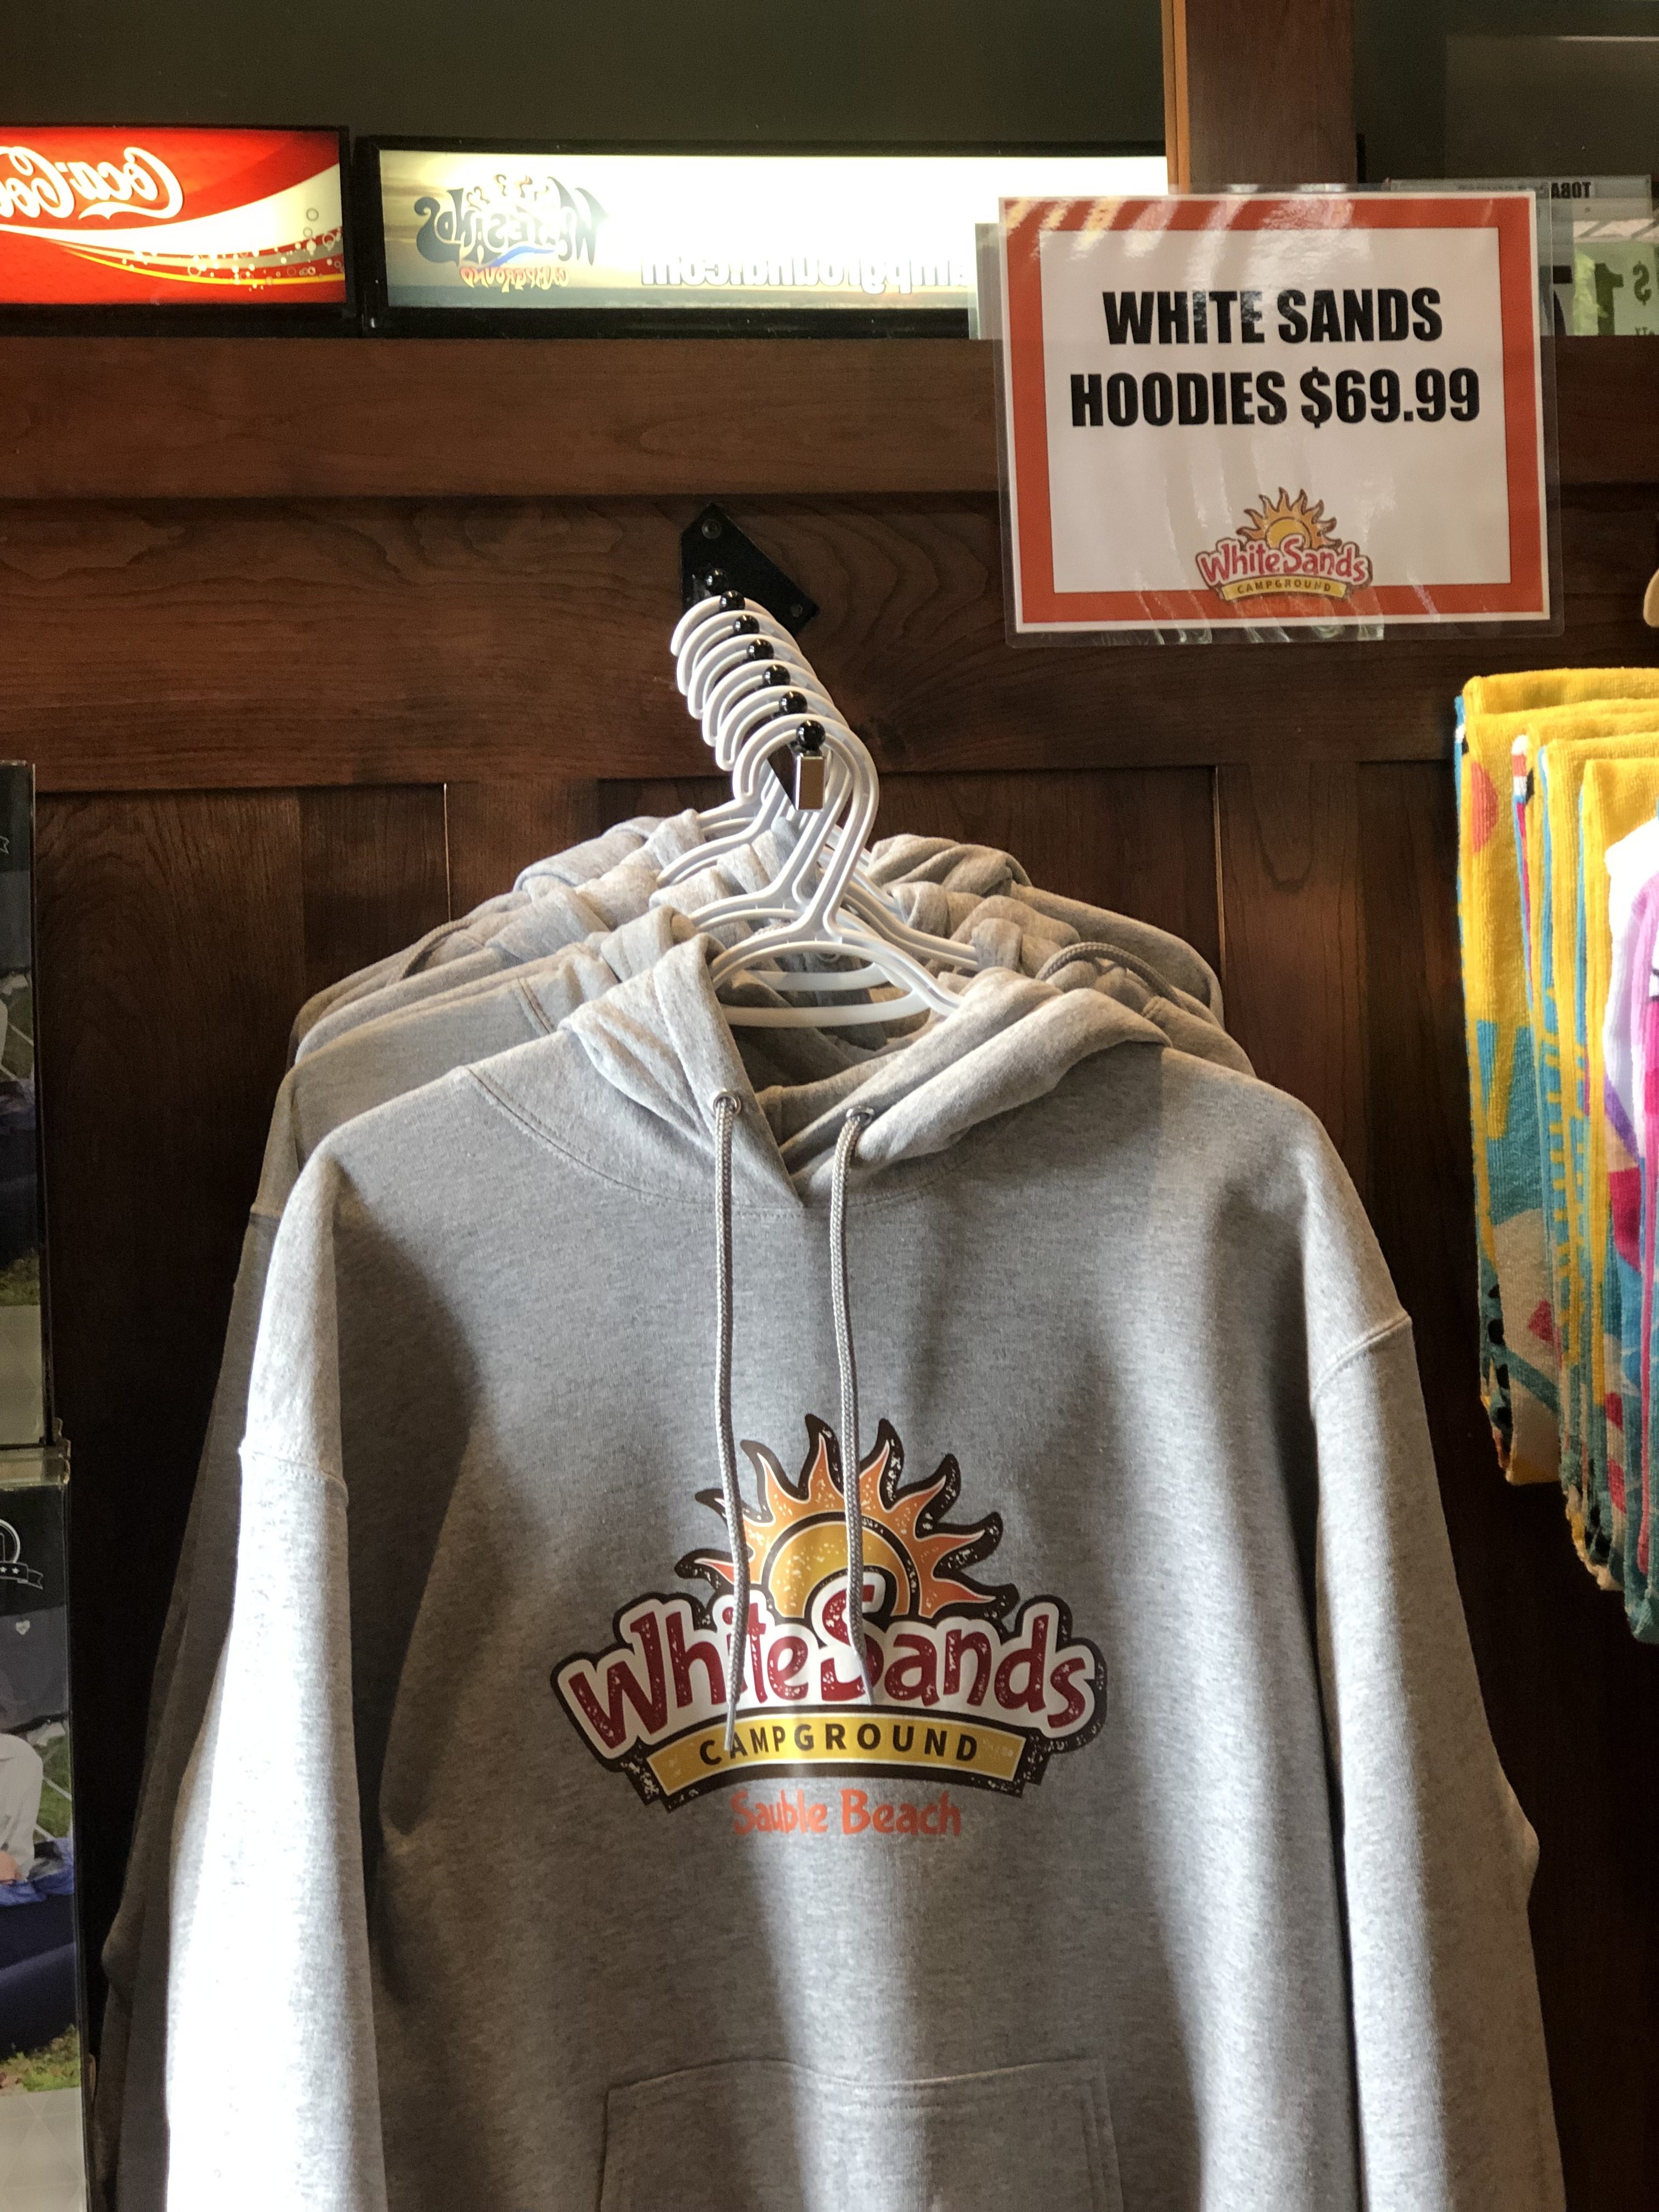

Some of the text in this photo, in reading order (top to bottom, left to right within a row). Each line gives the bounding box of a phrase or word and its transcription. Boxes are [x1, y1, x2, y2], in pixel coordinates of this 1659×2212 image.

[1102, 287, 1443, 345] WHITE SANDS
[1070, 366, 1480, 429] HOODIES $69.99
[1237, 579, 1331, 594] CAMPGROUND
[699, 1723, 978, 1765] CAMPGROUND
[730, 1788, 962, 1836] Sauble Beach
